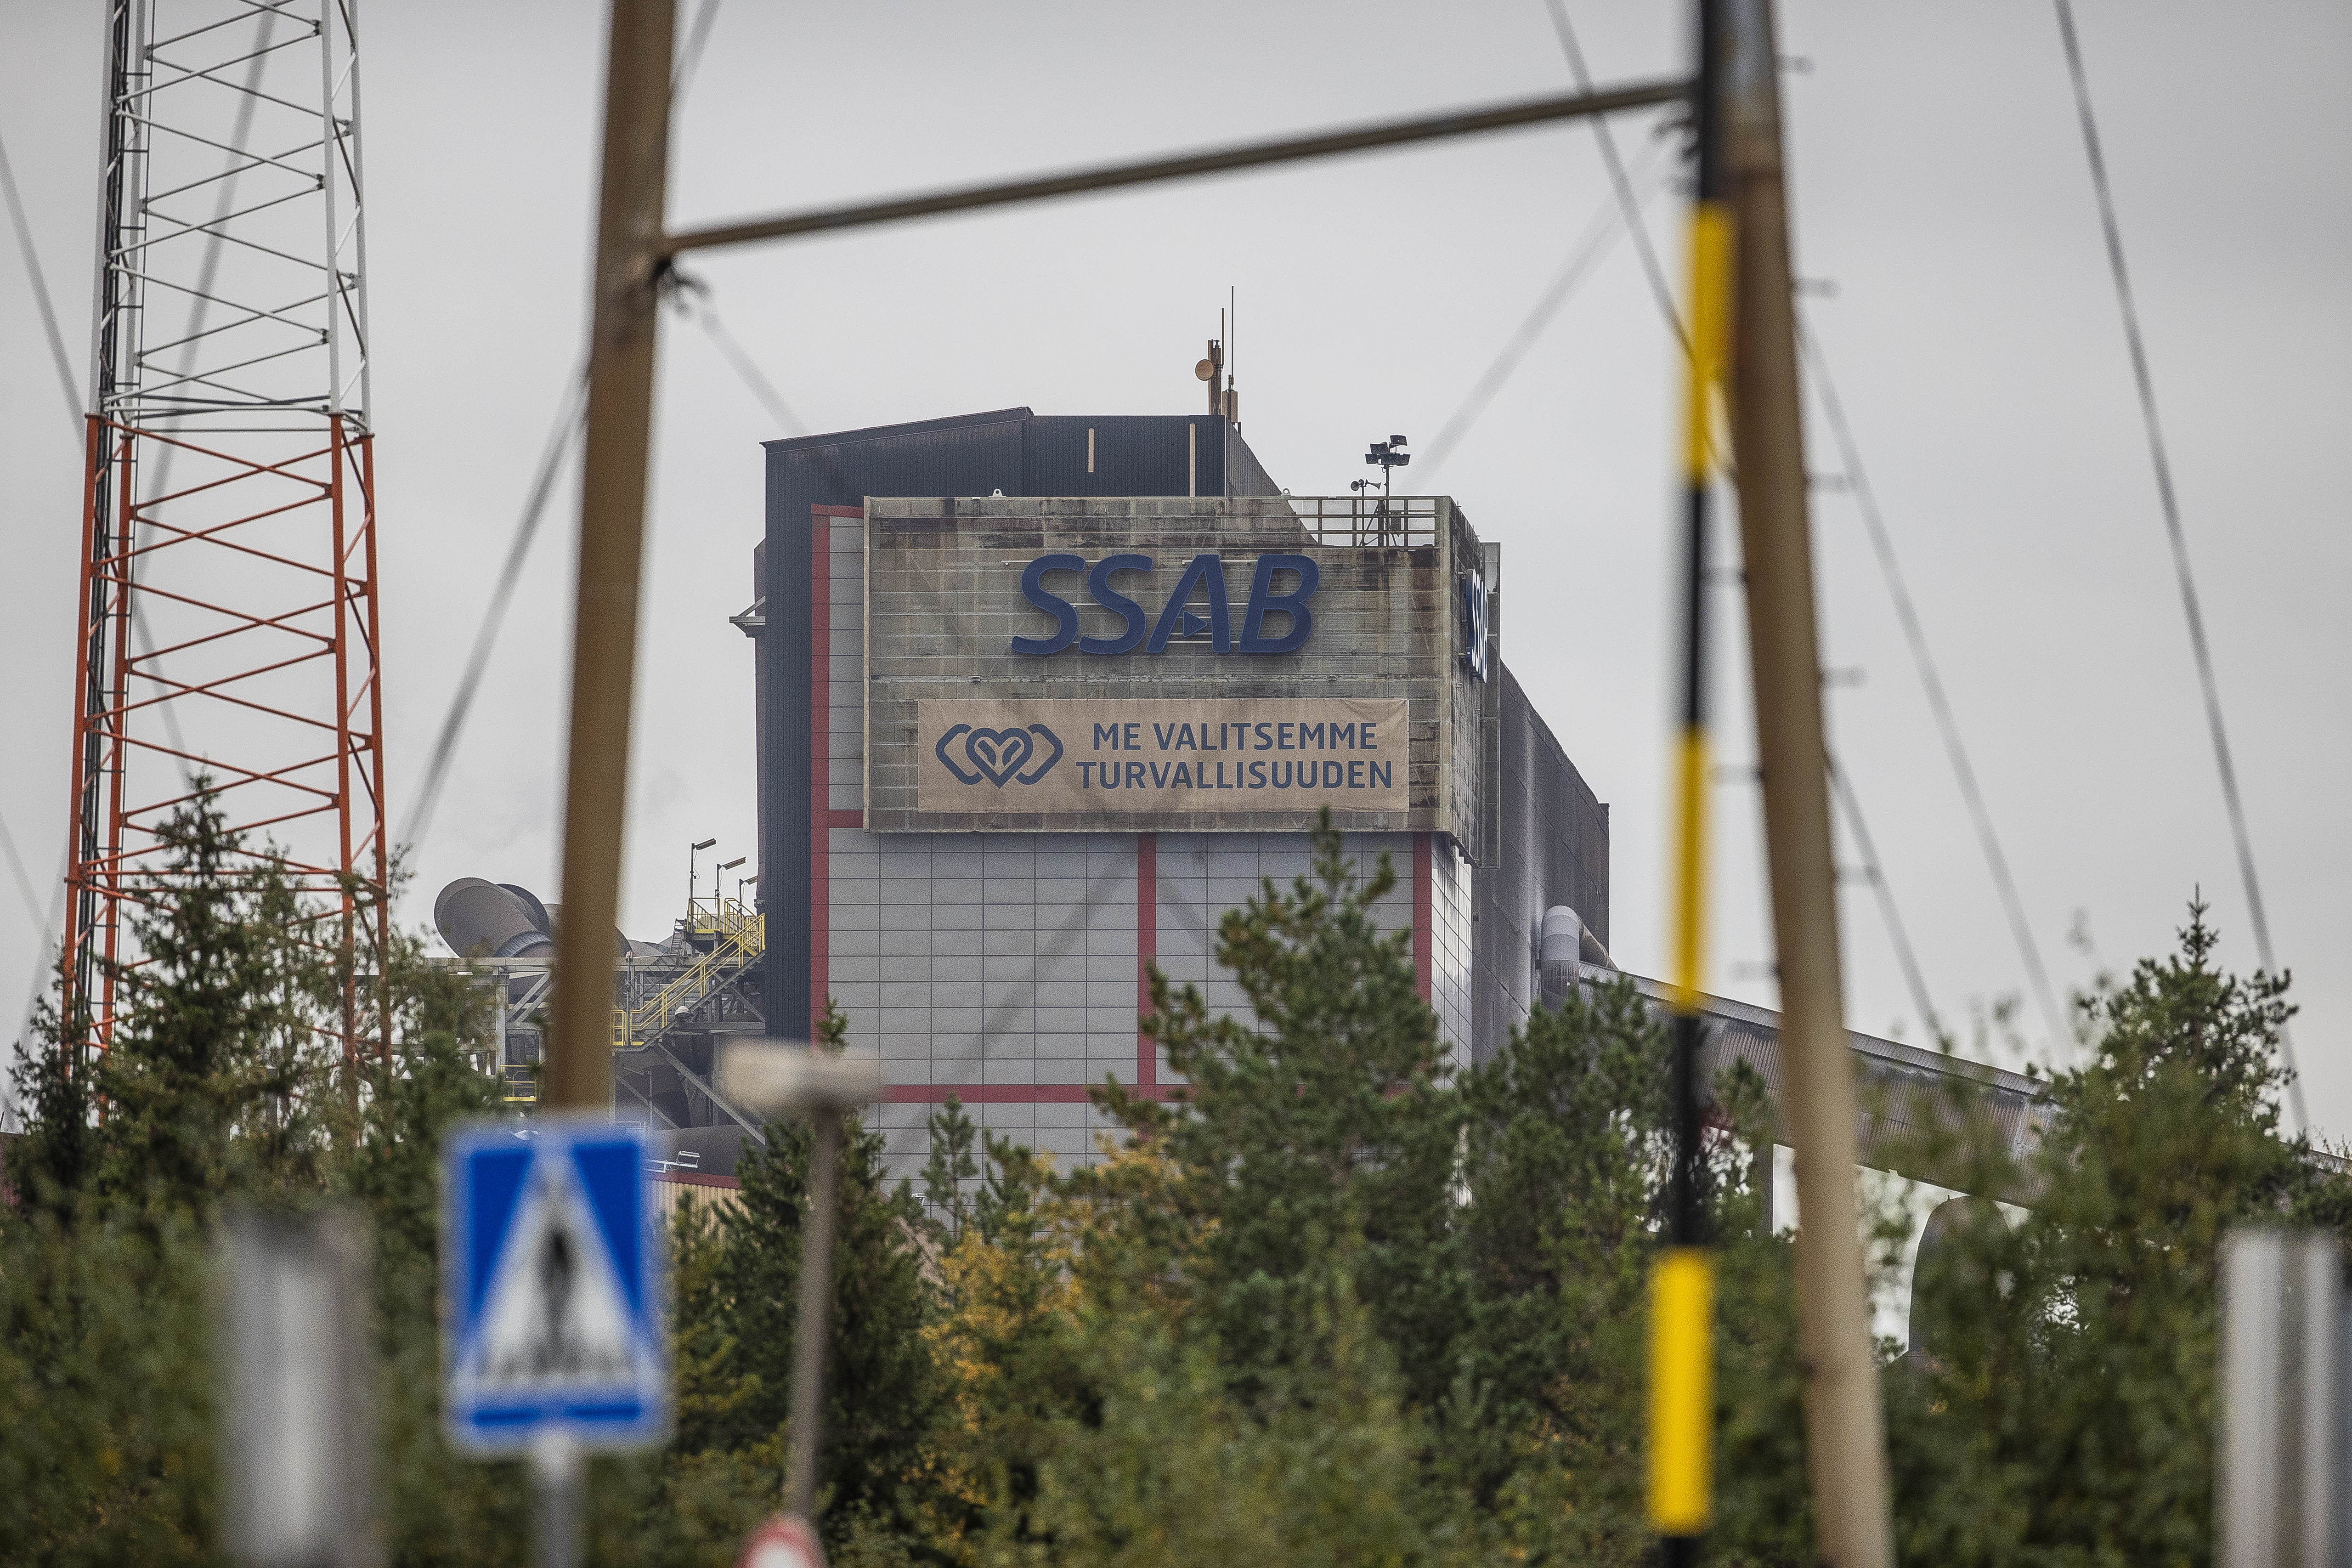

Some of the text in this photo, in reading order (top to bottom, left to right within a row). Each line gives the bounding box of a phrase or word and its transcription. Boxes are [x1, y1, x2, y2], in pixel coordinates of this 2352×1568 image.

[1011, 554, 1320, 655] SSAB
[1094, 723, 1377, 750] ME VALITSEMME
[1076, 761, 1391, 789] TURVALLISUUDEN
